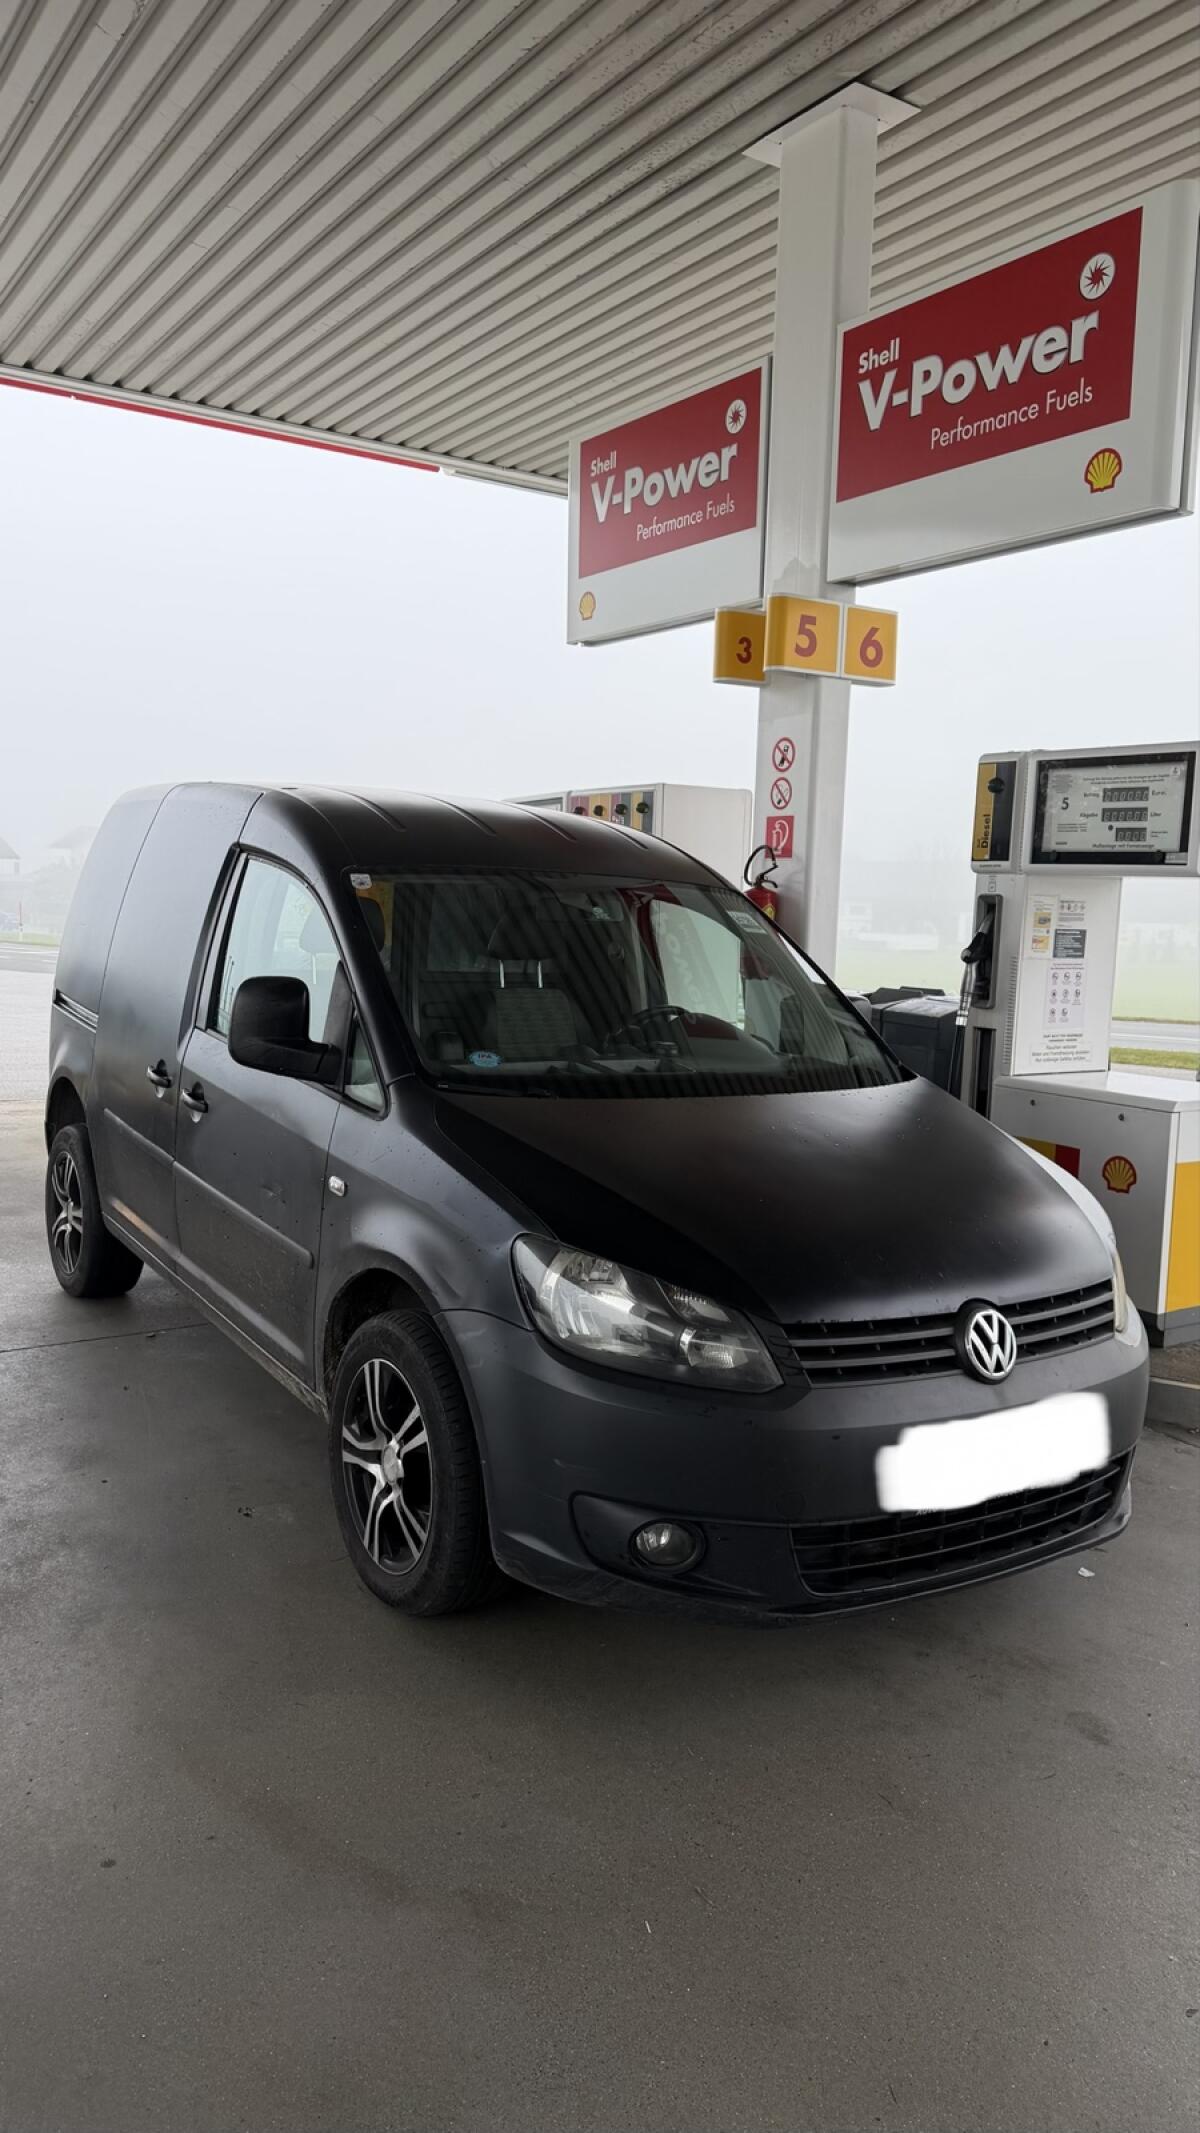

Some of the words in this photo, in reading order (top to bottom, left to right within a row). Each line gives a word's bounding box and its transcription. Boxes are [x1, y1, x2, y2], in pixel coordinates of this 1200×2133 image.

[858, 338, 900, 374] Shell
[858, 310, 1099, 431] V-Power
[931, 403, 1039, 449] Performance
[1045, 377, 1093, 414] Fuels
[590, 450, 617, 477] Shell
[591, 443, 738, 523] V-Power
[636, 509, 703, 541] Performance
[706, 493, 735, 520] Fuels
[736, 636, 753, 664] 3
[795, 614, 817, 657] 5
[859, 626, 883, 668] 6
[1061, 797, 1070, 810] 5
[981, 814, 991, 848] Diesel
[966, 1308, 1016, 1379] VW
